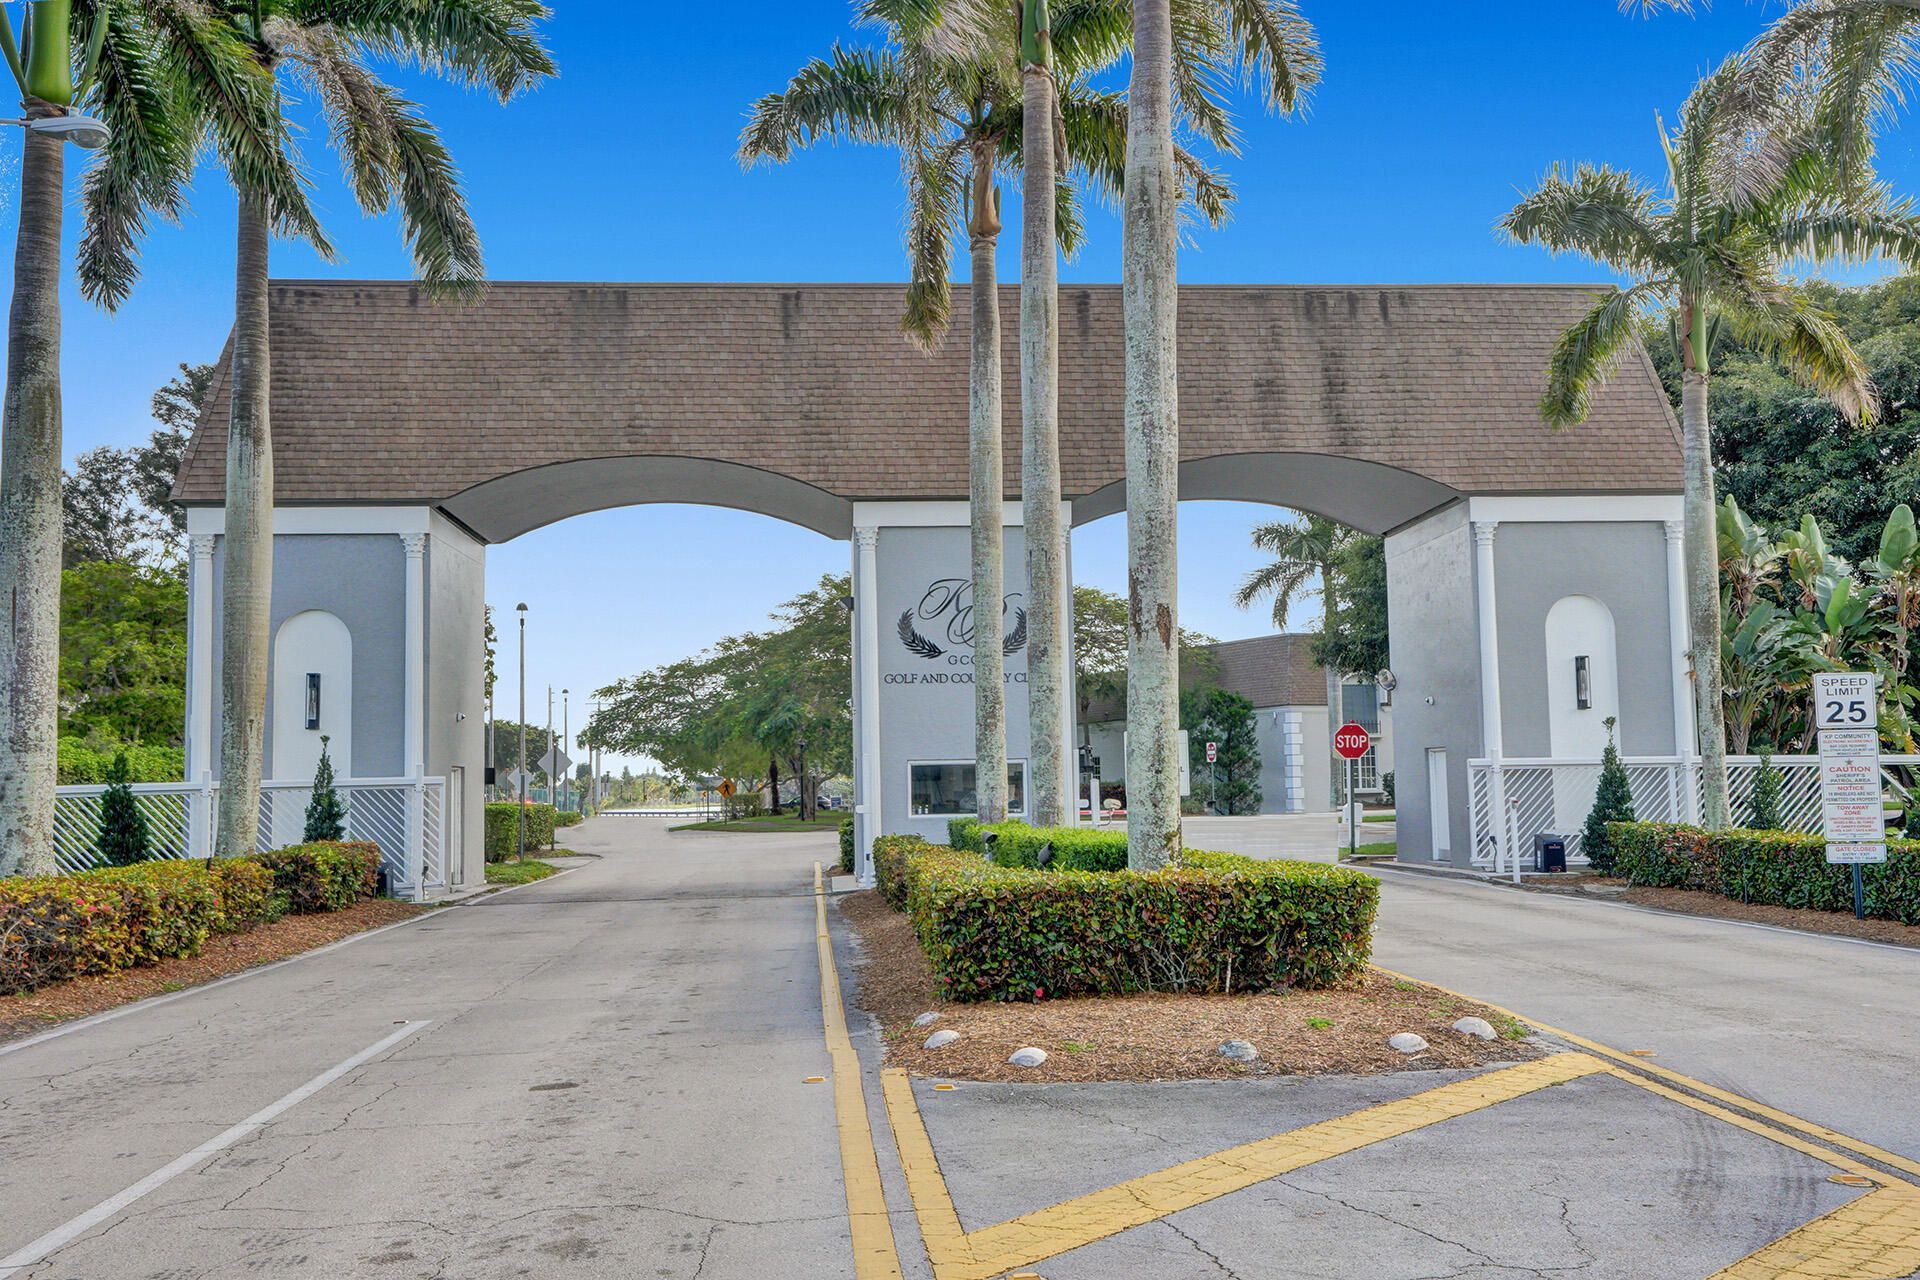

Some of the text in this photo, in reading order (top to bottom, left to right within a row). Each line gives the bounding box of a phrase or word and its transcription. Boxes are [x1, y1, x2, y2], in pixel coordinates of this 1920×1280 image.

[884, 673, 919, 684] GOLF
[920, 673, 949, 684] AND
[951, 672, 1012, 684] COUY
[1821, 678, 1868, 686] SPEED
[1826, 687, 1862, 696] LIMIT
[1825, 700, 1867, 723] 25
[1336, 735, 1367, 748] STOP
